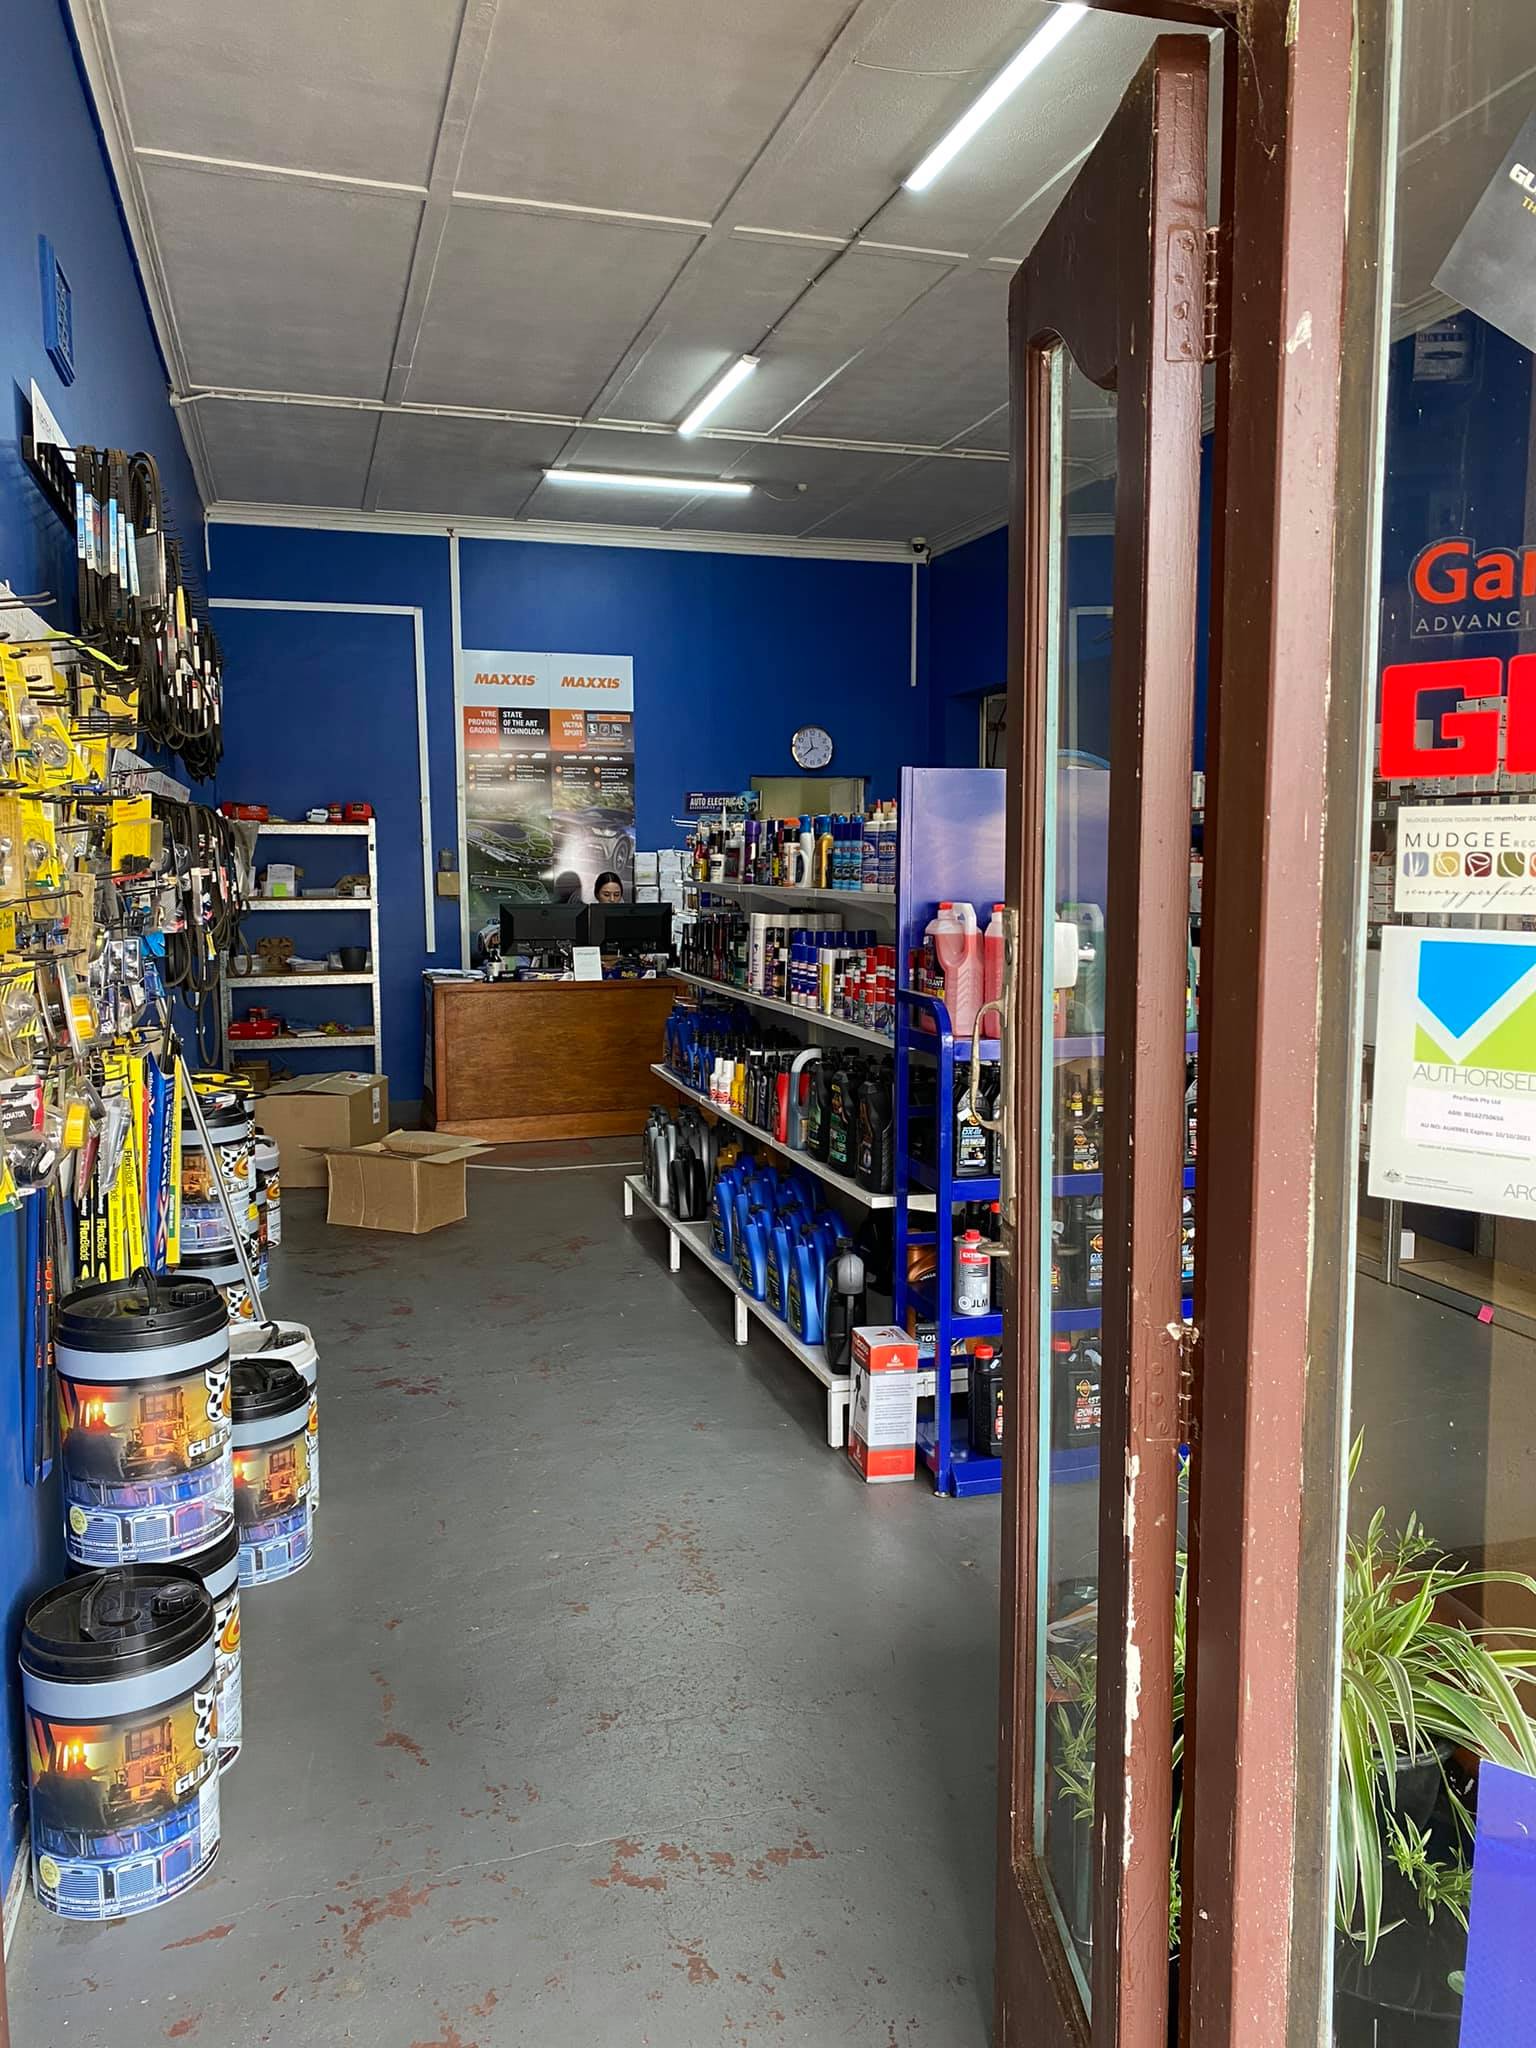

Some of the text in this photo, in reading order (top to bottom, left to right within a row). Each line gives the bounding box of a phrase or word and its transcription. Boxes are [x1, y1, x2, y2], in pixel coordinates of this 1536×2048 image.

[474, 673, 537, 686] MAXXIS
[561, 676, 621, 689] MAXXIS
[1379, 655, 1536, 779] G
[503, 719, 512, 727] OF
[469, 727, 497, 735] GROUND
[503, 728, 545, 736] TECHNOLOGY
[690, 797, 706, 806] AUTO
[1493, 814, 1526, 822] member
[1405, 832, 1511, 848] MUDGEE
[2, 1110, 27, 1121] ADIATOR
